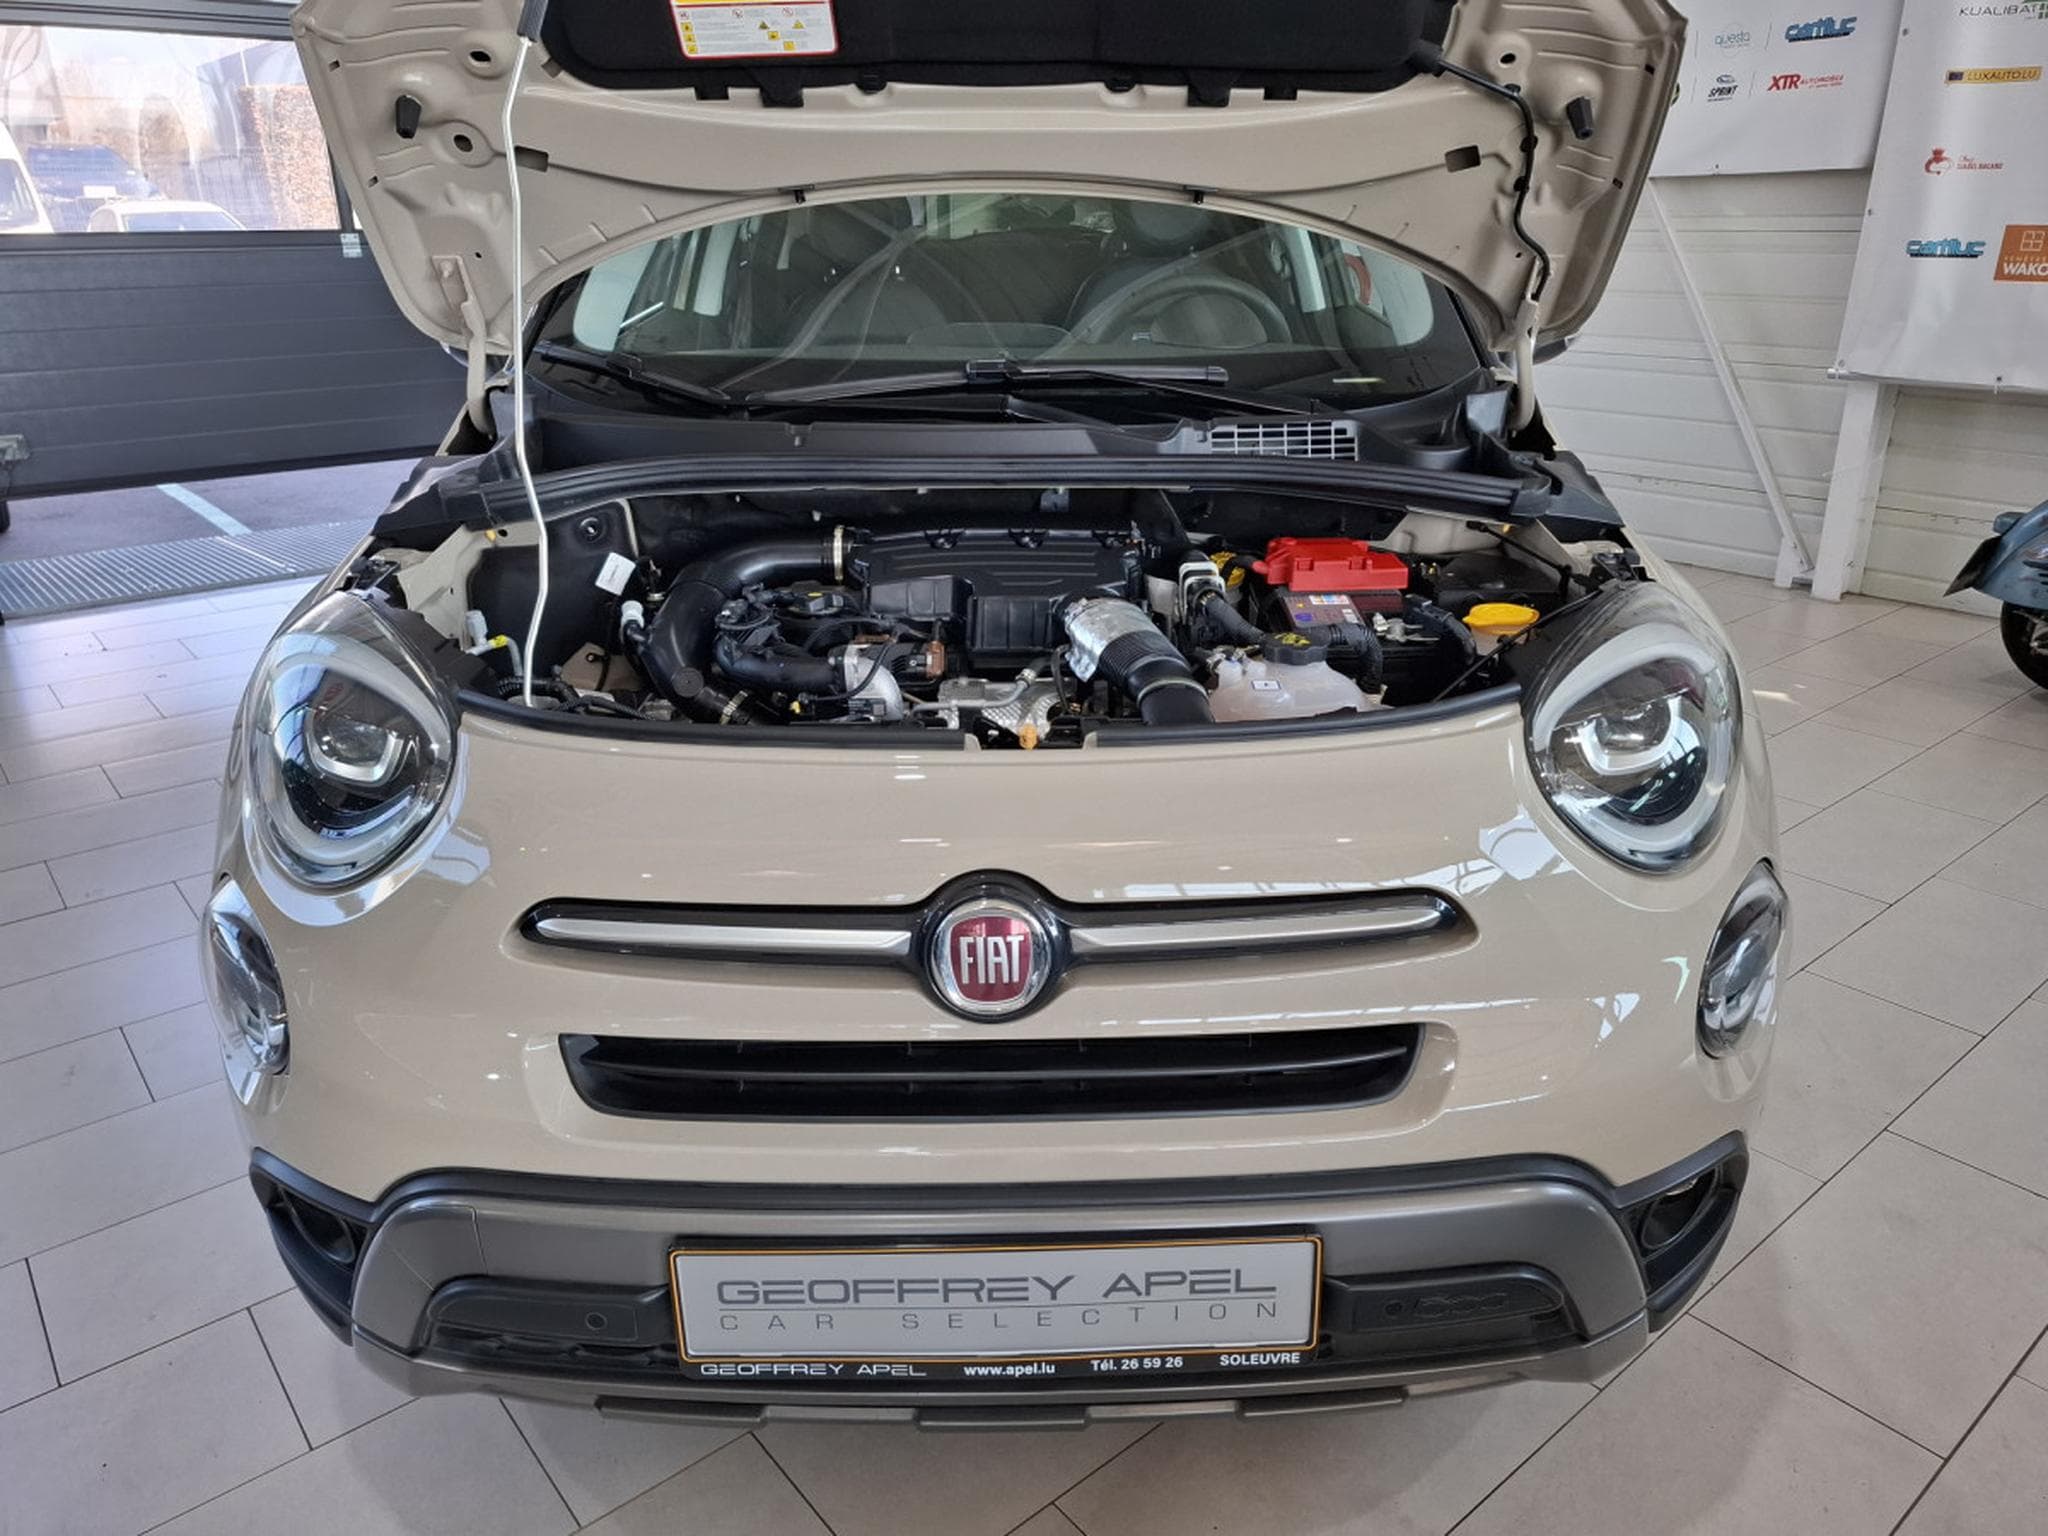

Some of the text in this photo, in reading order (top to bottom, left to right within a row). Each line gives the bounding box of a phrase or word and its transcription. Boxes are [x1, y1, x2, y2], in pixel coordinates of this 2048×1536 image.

[1767, 73, 1801, 92] XTR
[959, 934, 1025, 985] FIAT
[717, 1268, 1277, 1305] GEOFFREY APEL
[720, 1302, 1277, 1330] CAR SELECTION
[700, 1363, 844, 1376] GEOFFREY
[856, 1363, 927, 1377] APEL
[963, 1361, 1056, 1376] www.apel.lu
[1121, 1358, 1139, 1370] 26
[1142, 1358, 1161, 1369] 59
[1165, 1356, 1183, 1368] 26
[1219, 1351, 1301, 1366] SOLEUVRE
